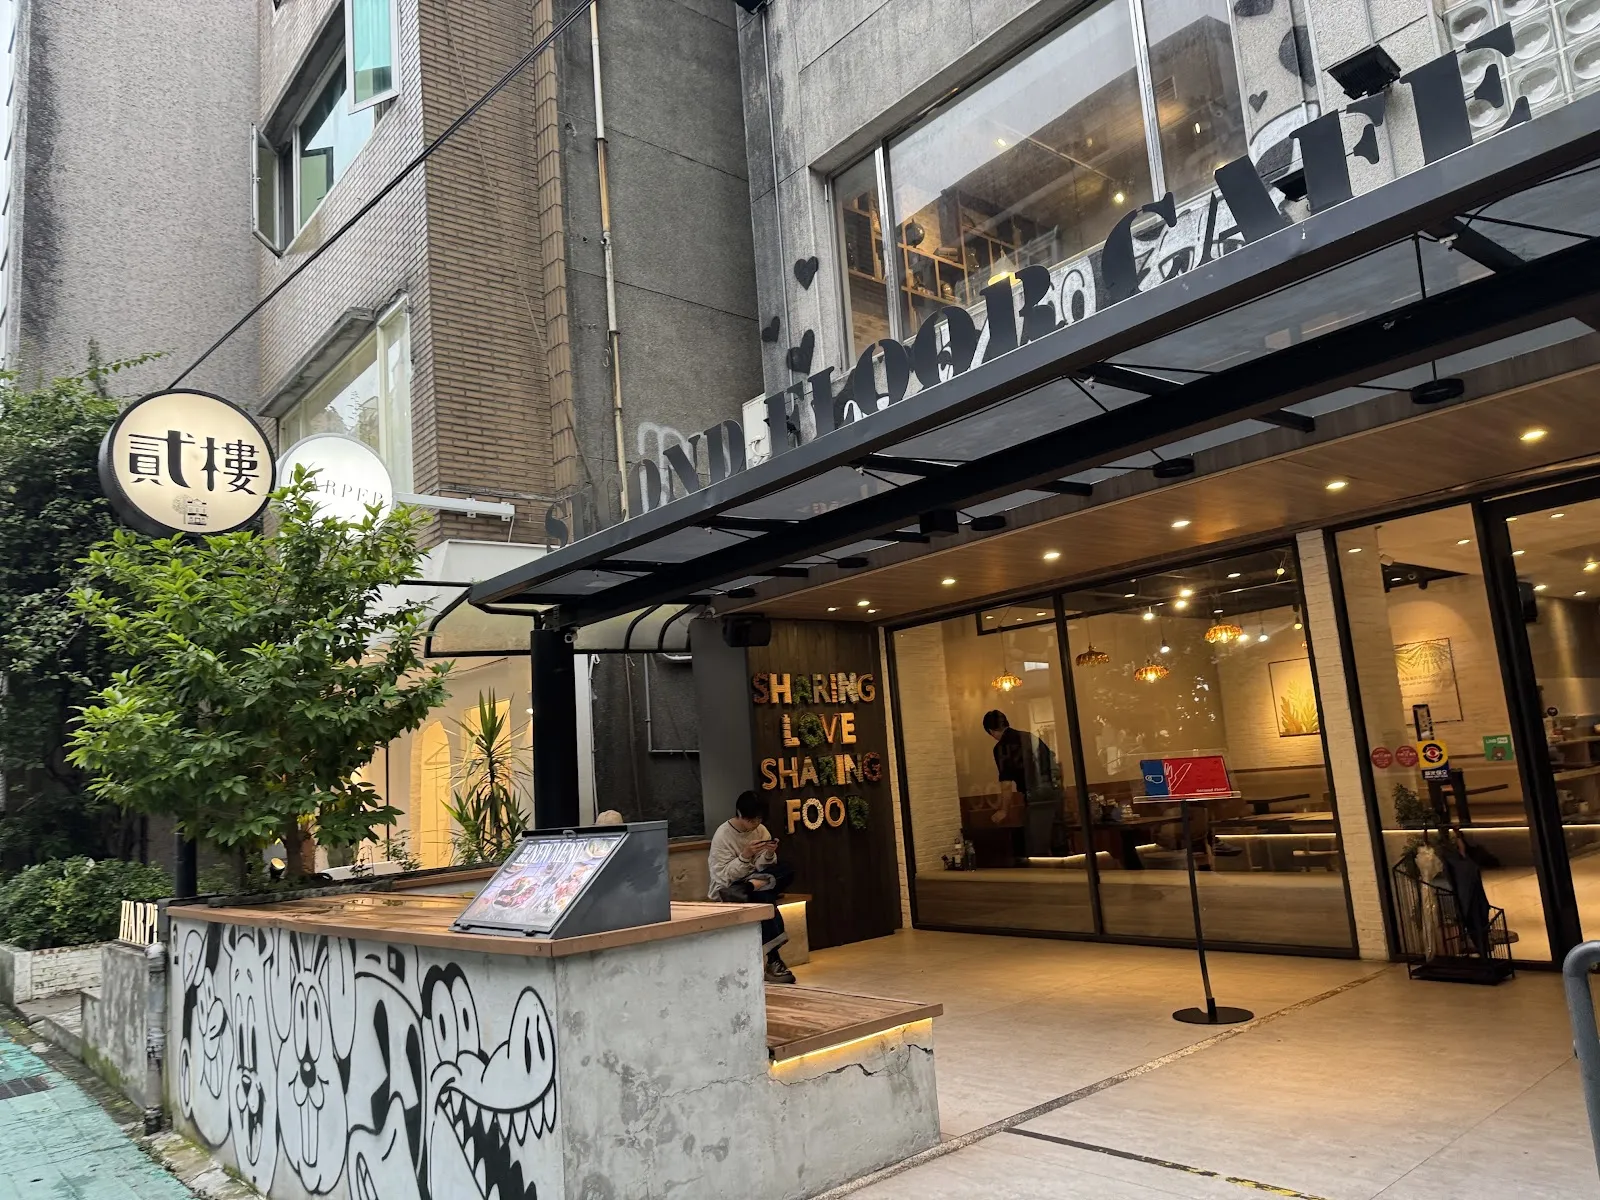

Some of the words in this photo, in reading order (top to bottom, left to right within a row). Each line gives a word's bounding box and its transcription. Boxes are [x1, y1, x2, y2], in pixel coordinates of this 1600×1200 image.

[764, 265, 1067, 453] FLOOR
[1102, 22, 1532, 308] CAFE
[129, 430, 259, 495] 貳樓
[752, 672, 876, 704] SHARING
[781, 712, 857, 747] LOVE
[761, 752, 883, 790] SHARING
[786, 796, 869, 835] FOOD
